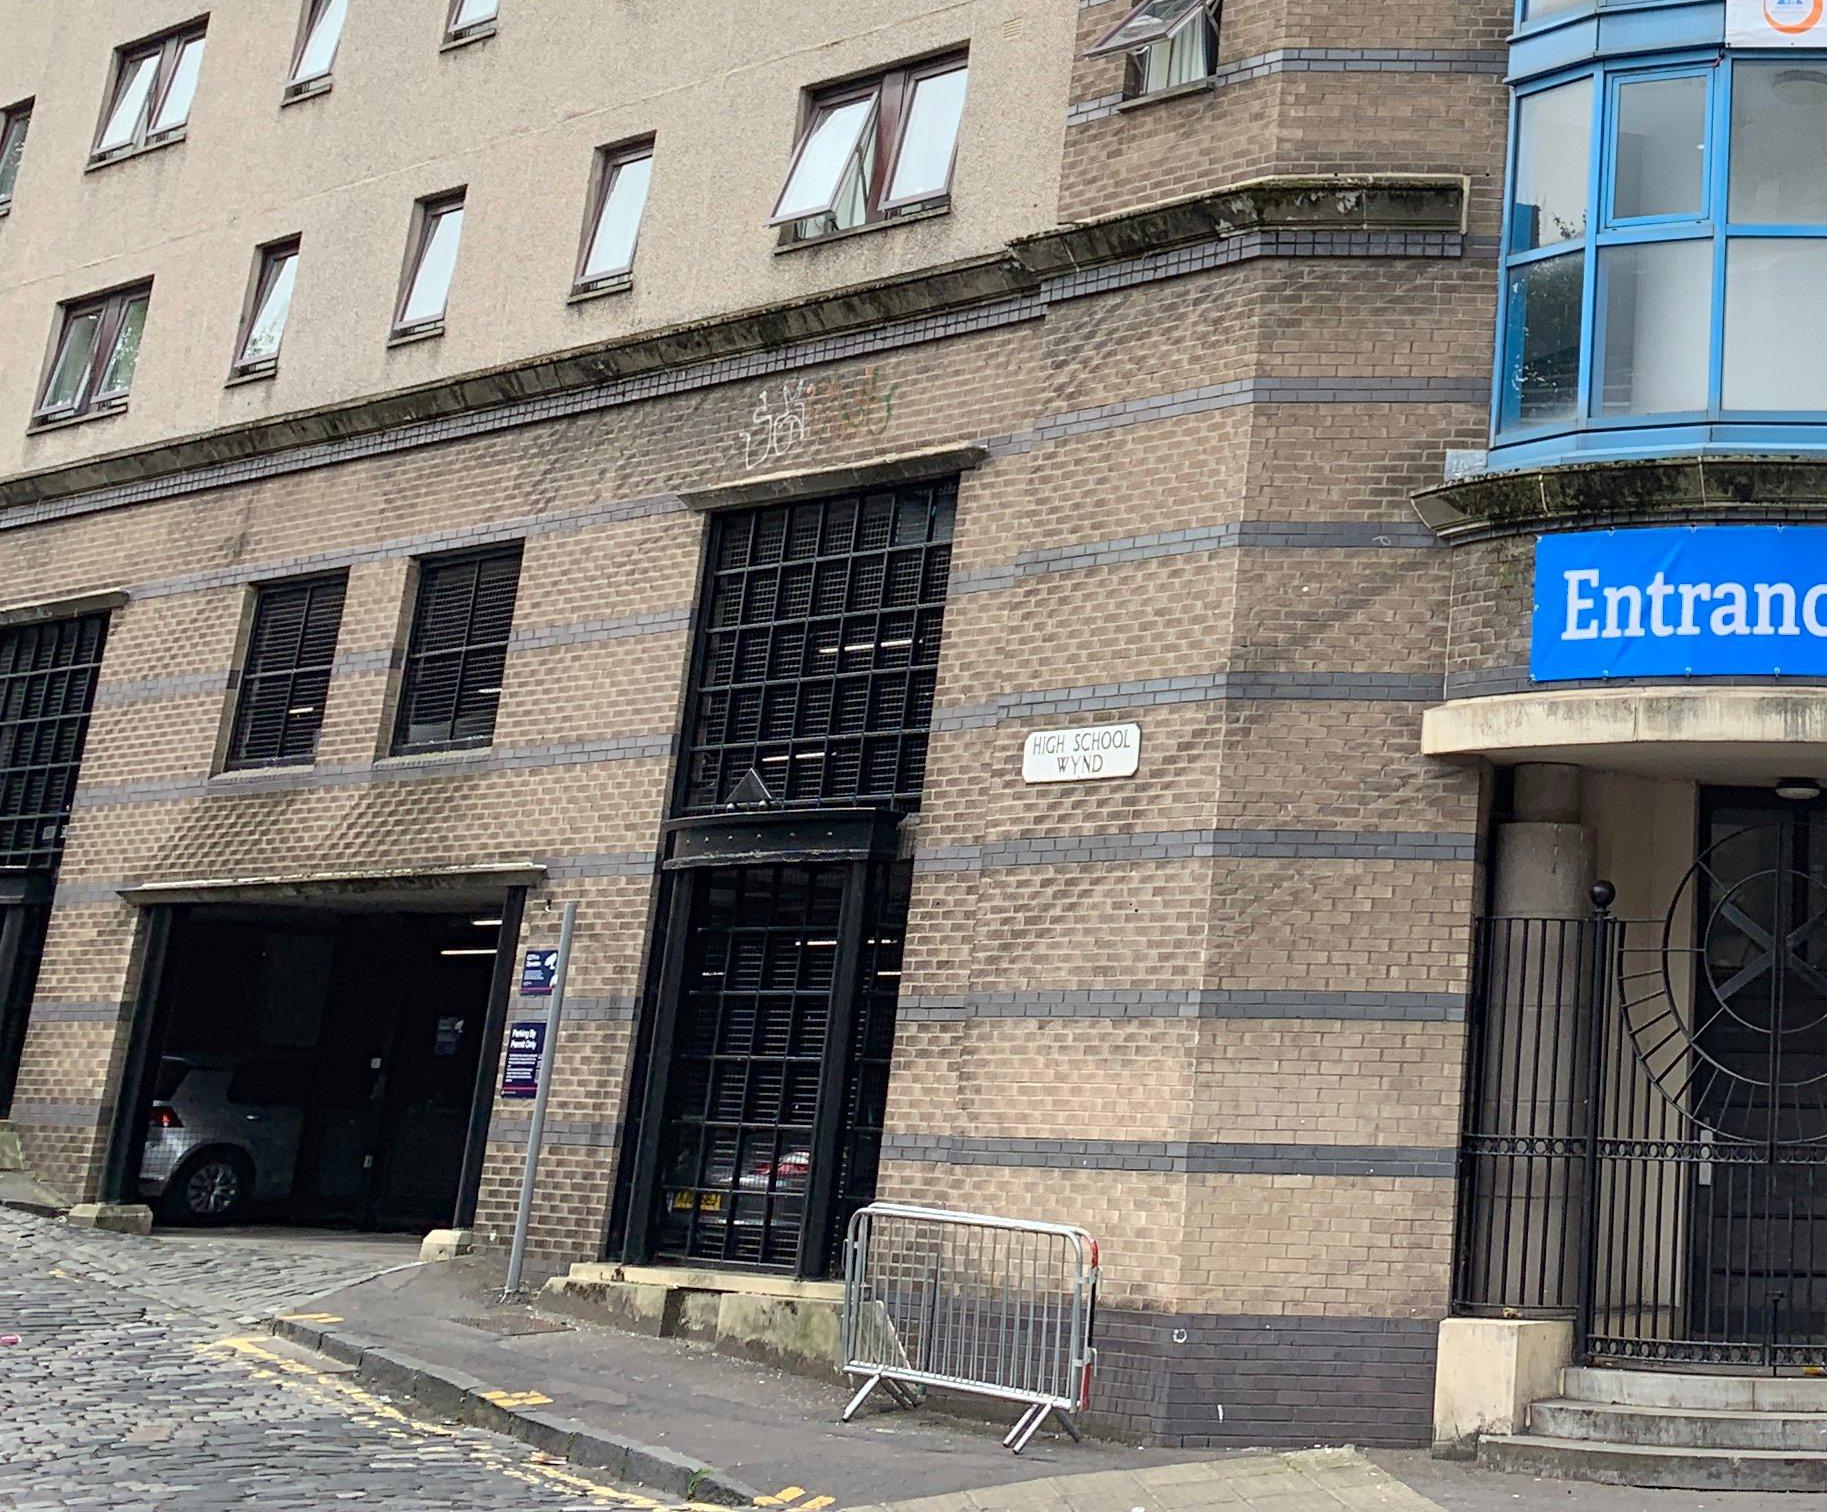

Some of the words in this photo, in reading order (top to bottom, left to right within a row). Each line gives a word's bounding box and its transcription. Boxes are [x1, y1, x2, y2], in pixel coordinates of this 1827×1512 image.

[1032, 734, 1066, 755] HIGH
[1073, 729, 1131, 752] SCHOOL
[1056, 754, 1104, 774] WYND
